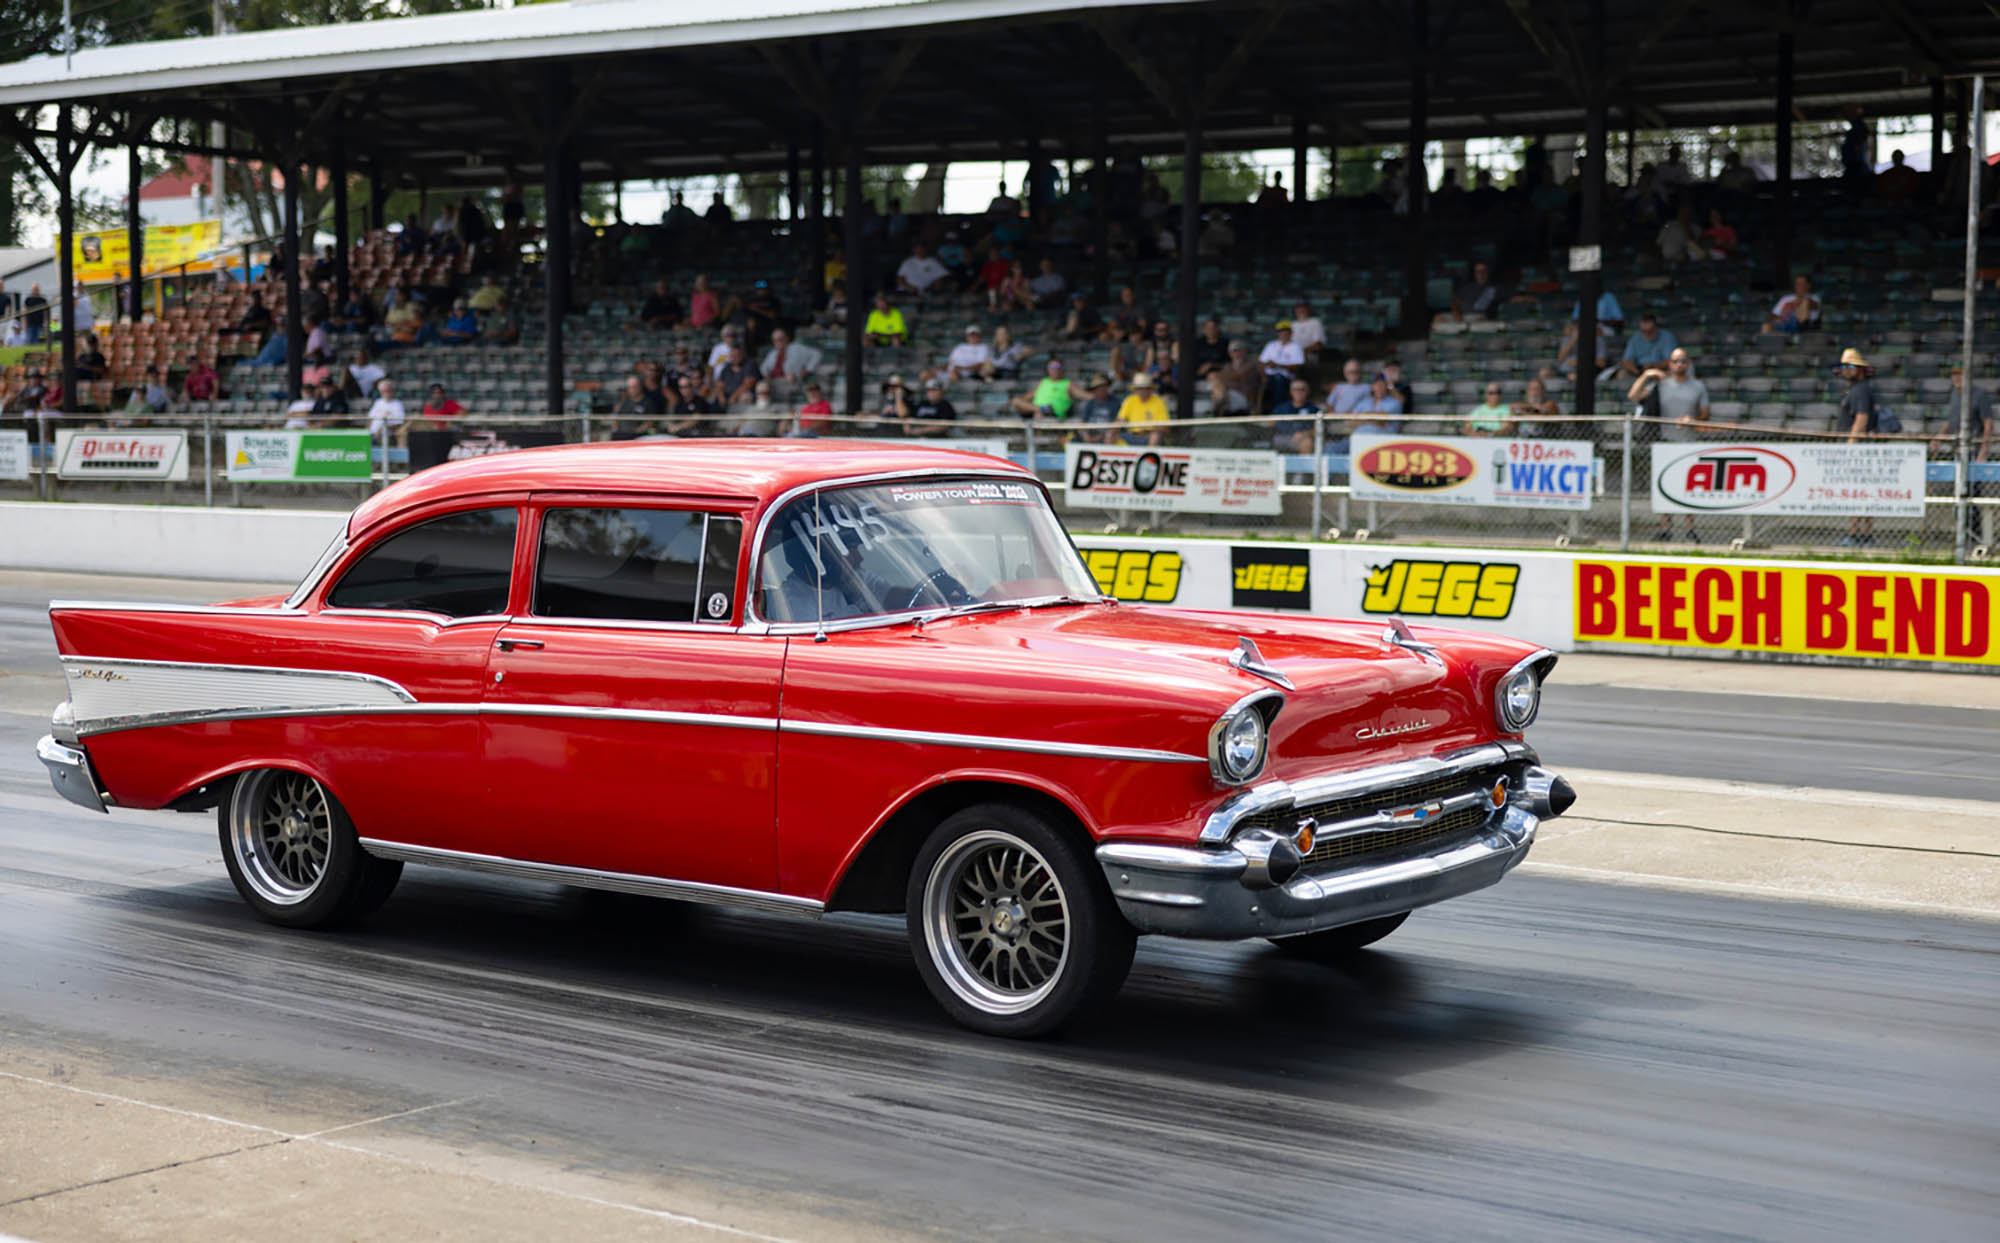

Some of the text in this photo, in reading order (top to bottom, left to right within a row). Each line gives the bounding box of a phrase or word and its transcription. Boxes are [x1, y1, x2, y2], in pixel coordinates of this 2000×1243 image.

[1376, 449, 1458, 475] D93
[1510, 463, 1588, 494] WKCT
[1078, 549, 1183, 602] EGS
[1234, 564, 1308, 592] JEGS
[1362, 559, 1520, 619] JEGS
[1578, 563, 1991, 658] BEECH BEND
[1355, 718, 1432, 740] Chevrolet
